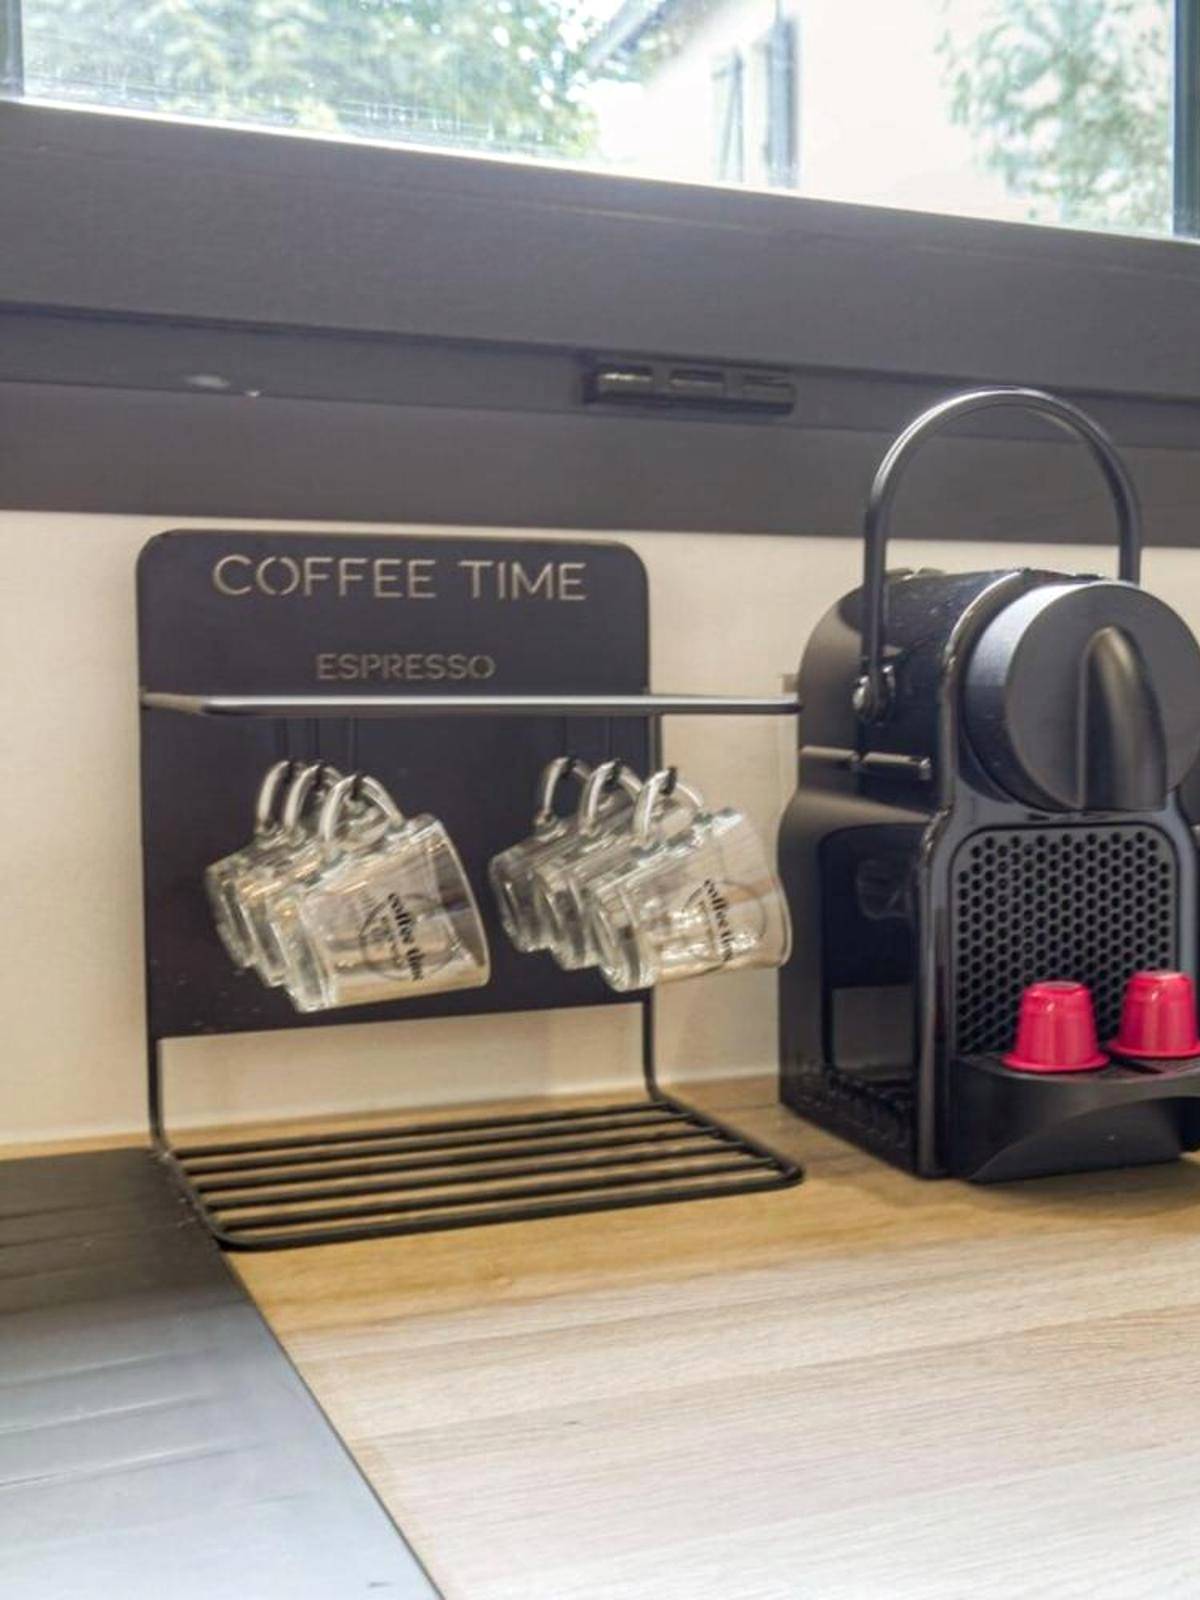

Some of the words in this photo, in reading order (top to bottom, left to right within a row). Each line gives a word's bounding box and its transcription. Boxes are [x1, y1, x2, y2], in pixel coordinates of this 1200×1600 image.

[210, 553, 437, 598] COFFEE
[458, 559, 588, 601] TIME
[315, 652, 496, 681] ESPRESSO
